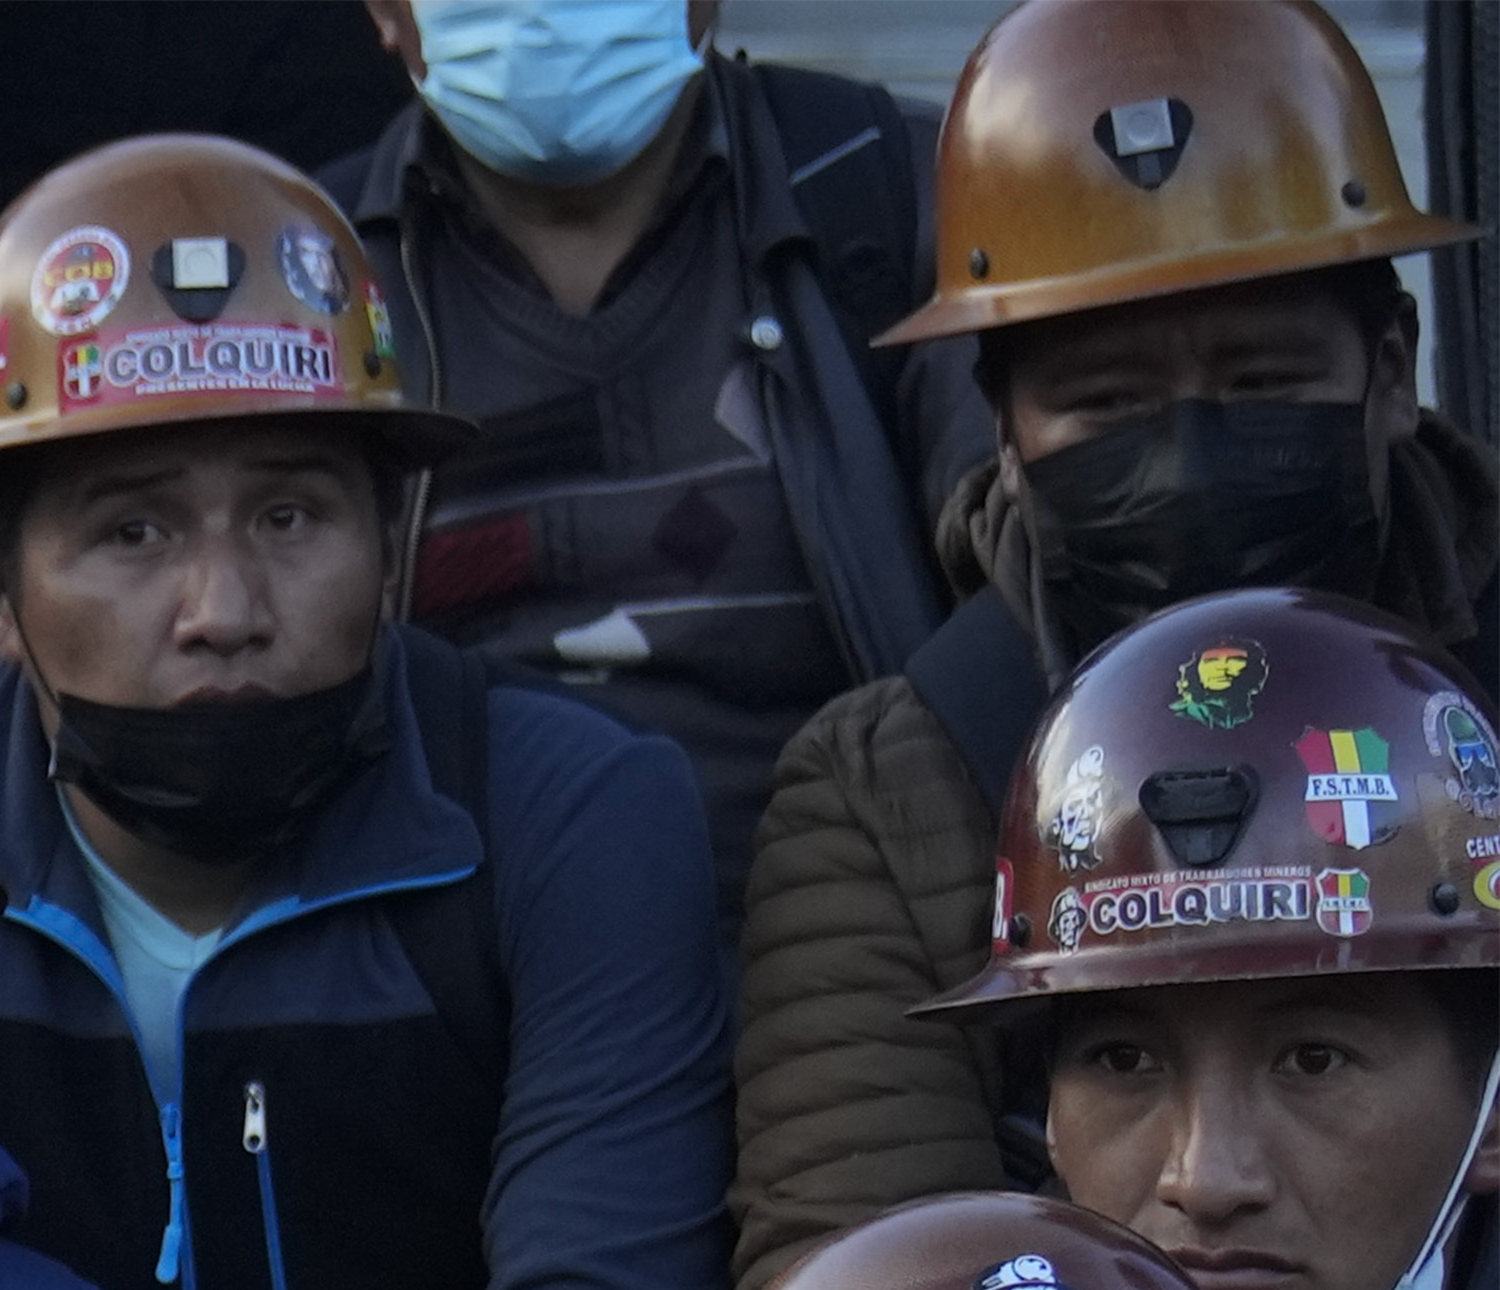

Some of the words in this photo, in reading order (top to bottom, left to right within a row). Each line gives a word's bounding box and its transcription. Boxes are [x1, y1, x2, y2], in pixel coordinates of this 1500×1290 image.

[107, 341, 333, 385] COLQUIRI
[1311, 777, 1391, 798] F.S.T.M.B.
[1090, 881, 1309, 935] COLQUIRI
